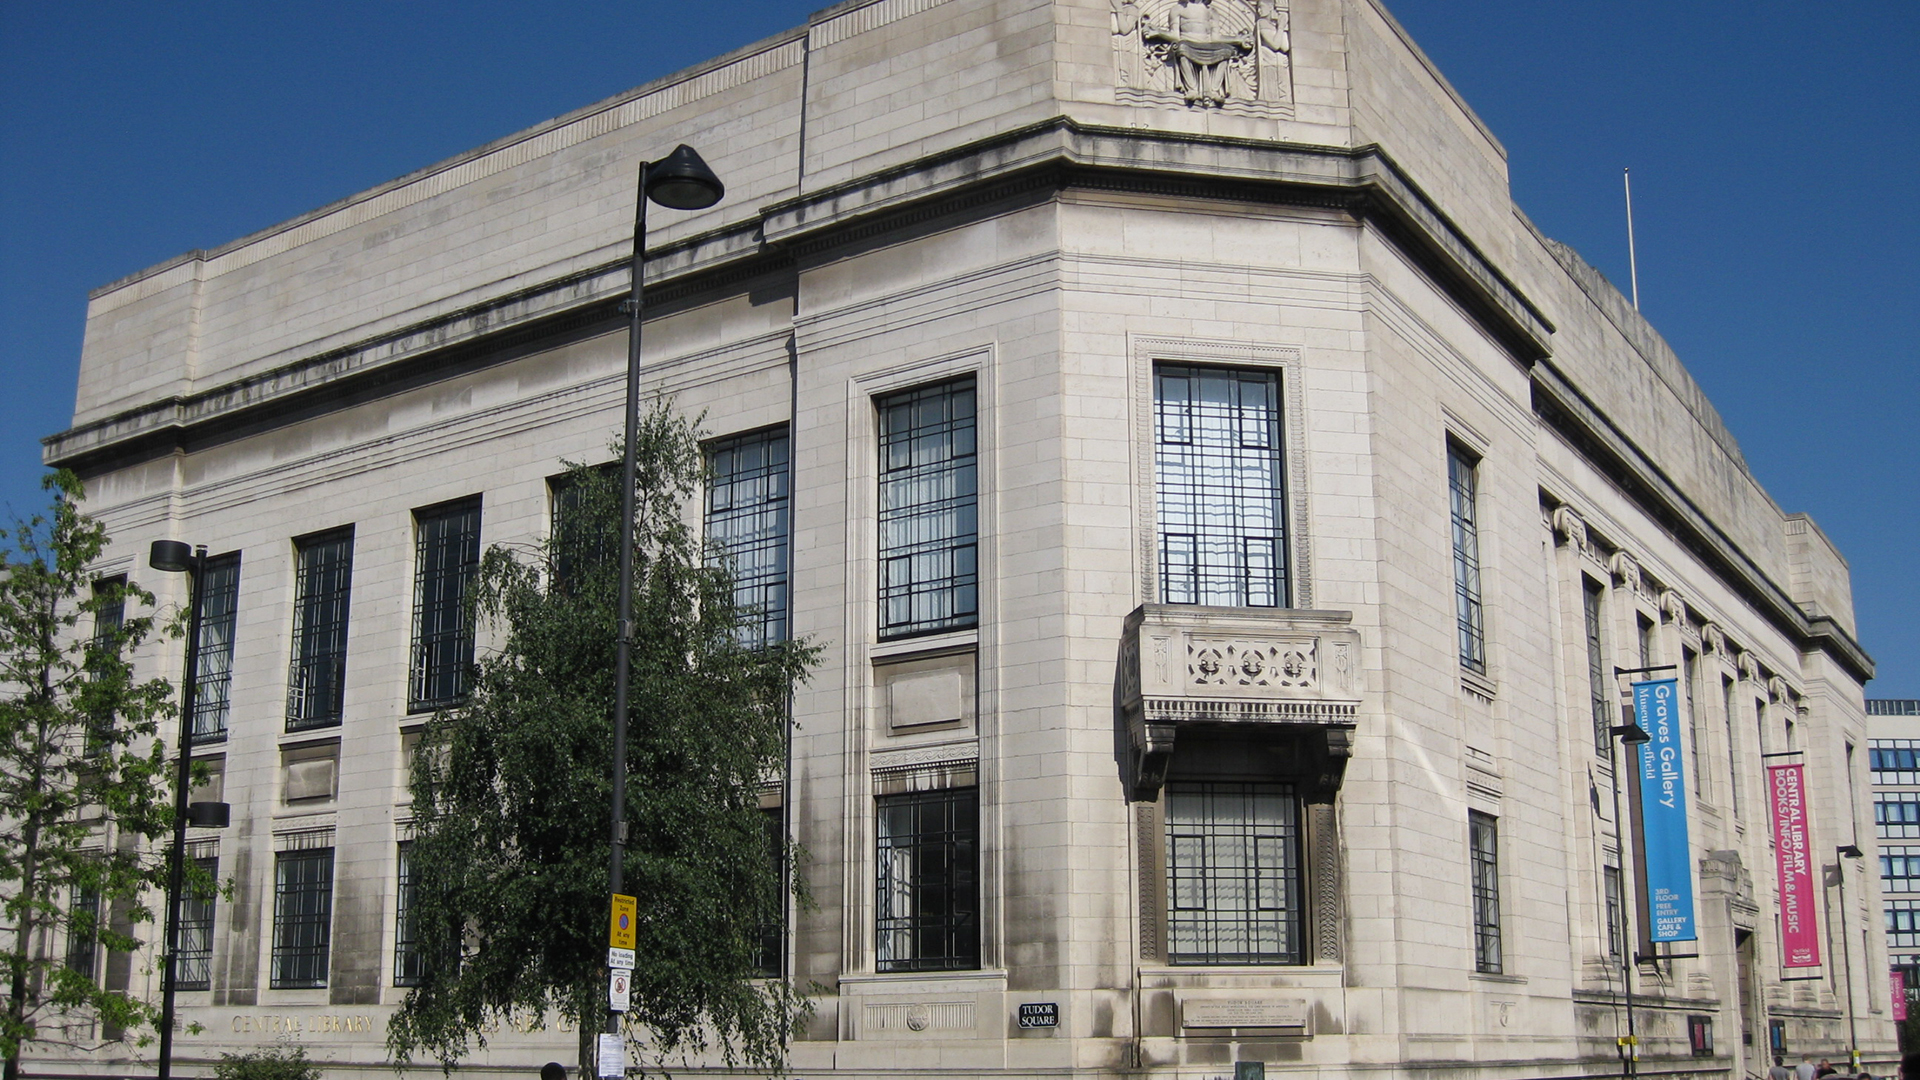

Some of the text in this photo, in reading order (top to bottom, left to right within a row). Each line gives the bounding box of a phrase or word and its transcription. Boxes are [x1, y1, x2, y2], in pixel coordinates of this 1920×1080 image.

[1655, 685, 1679, 808] Graves Gallery
[1786, 768, 1806, 876] CENTRAL LIBRARY
[1657, 916, 1687, 924] GALLERY
[1785, 894, 1800, 933] MUSIC
[1022, 1004, 1054, 1014] TUDOR
[231, 1014, 376, 1033] CENTRAL LIBRARY
[1021, 1015, 1055, 1027] SQUARE
